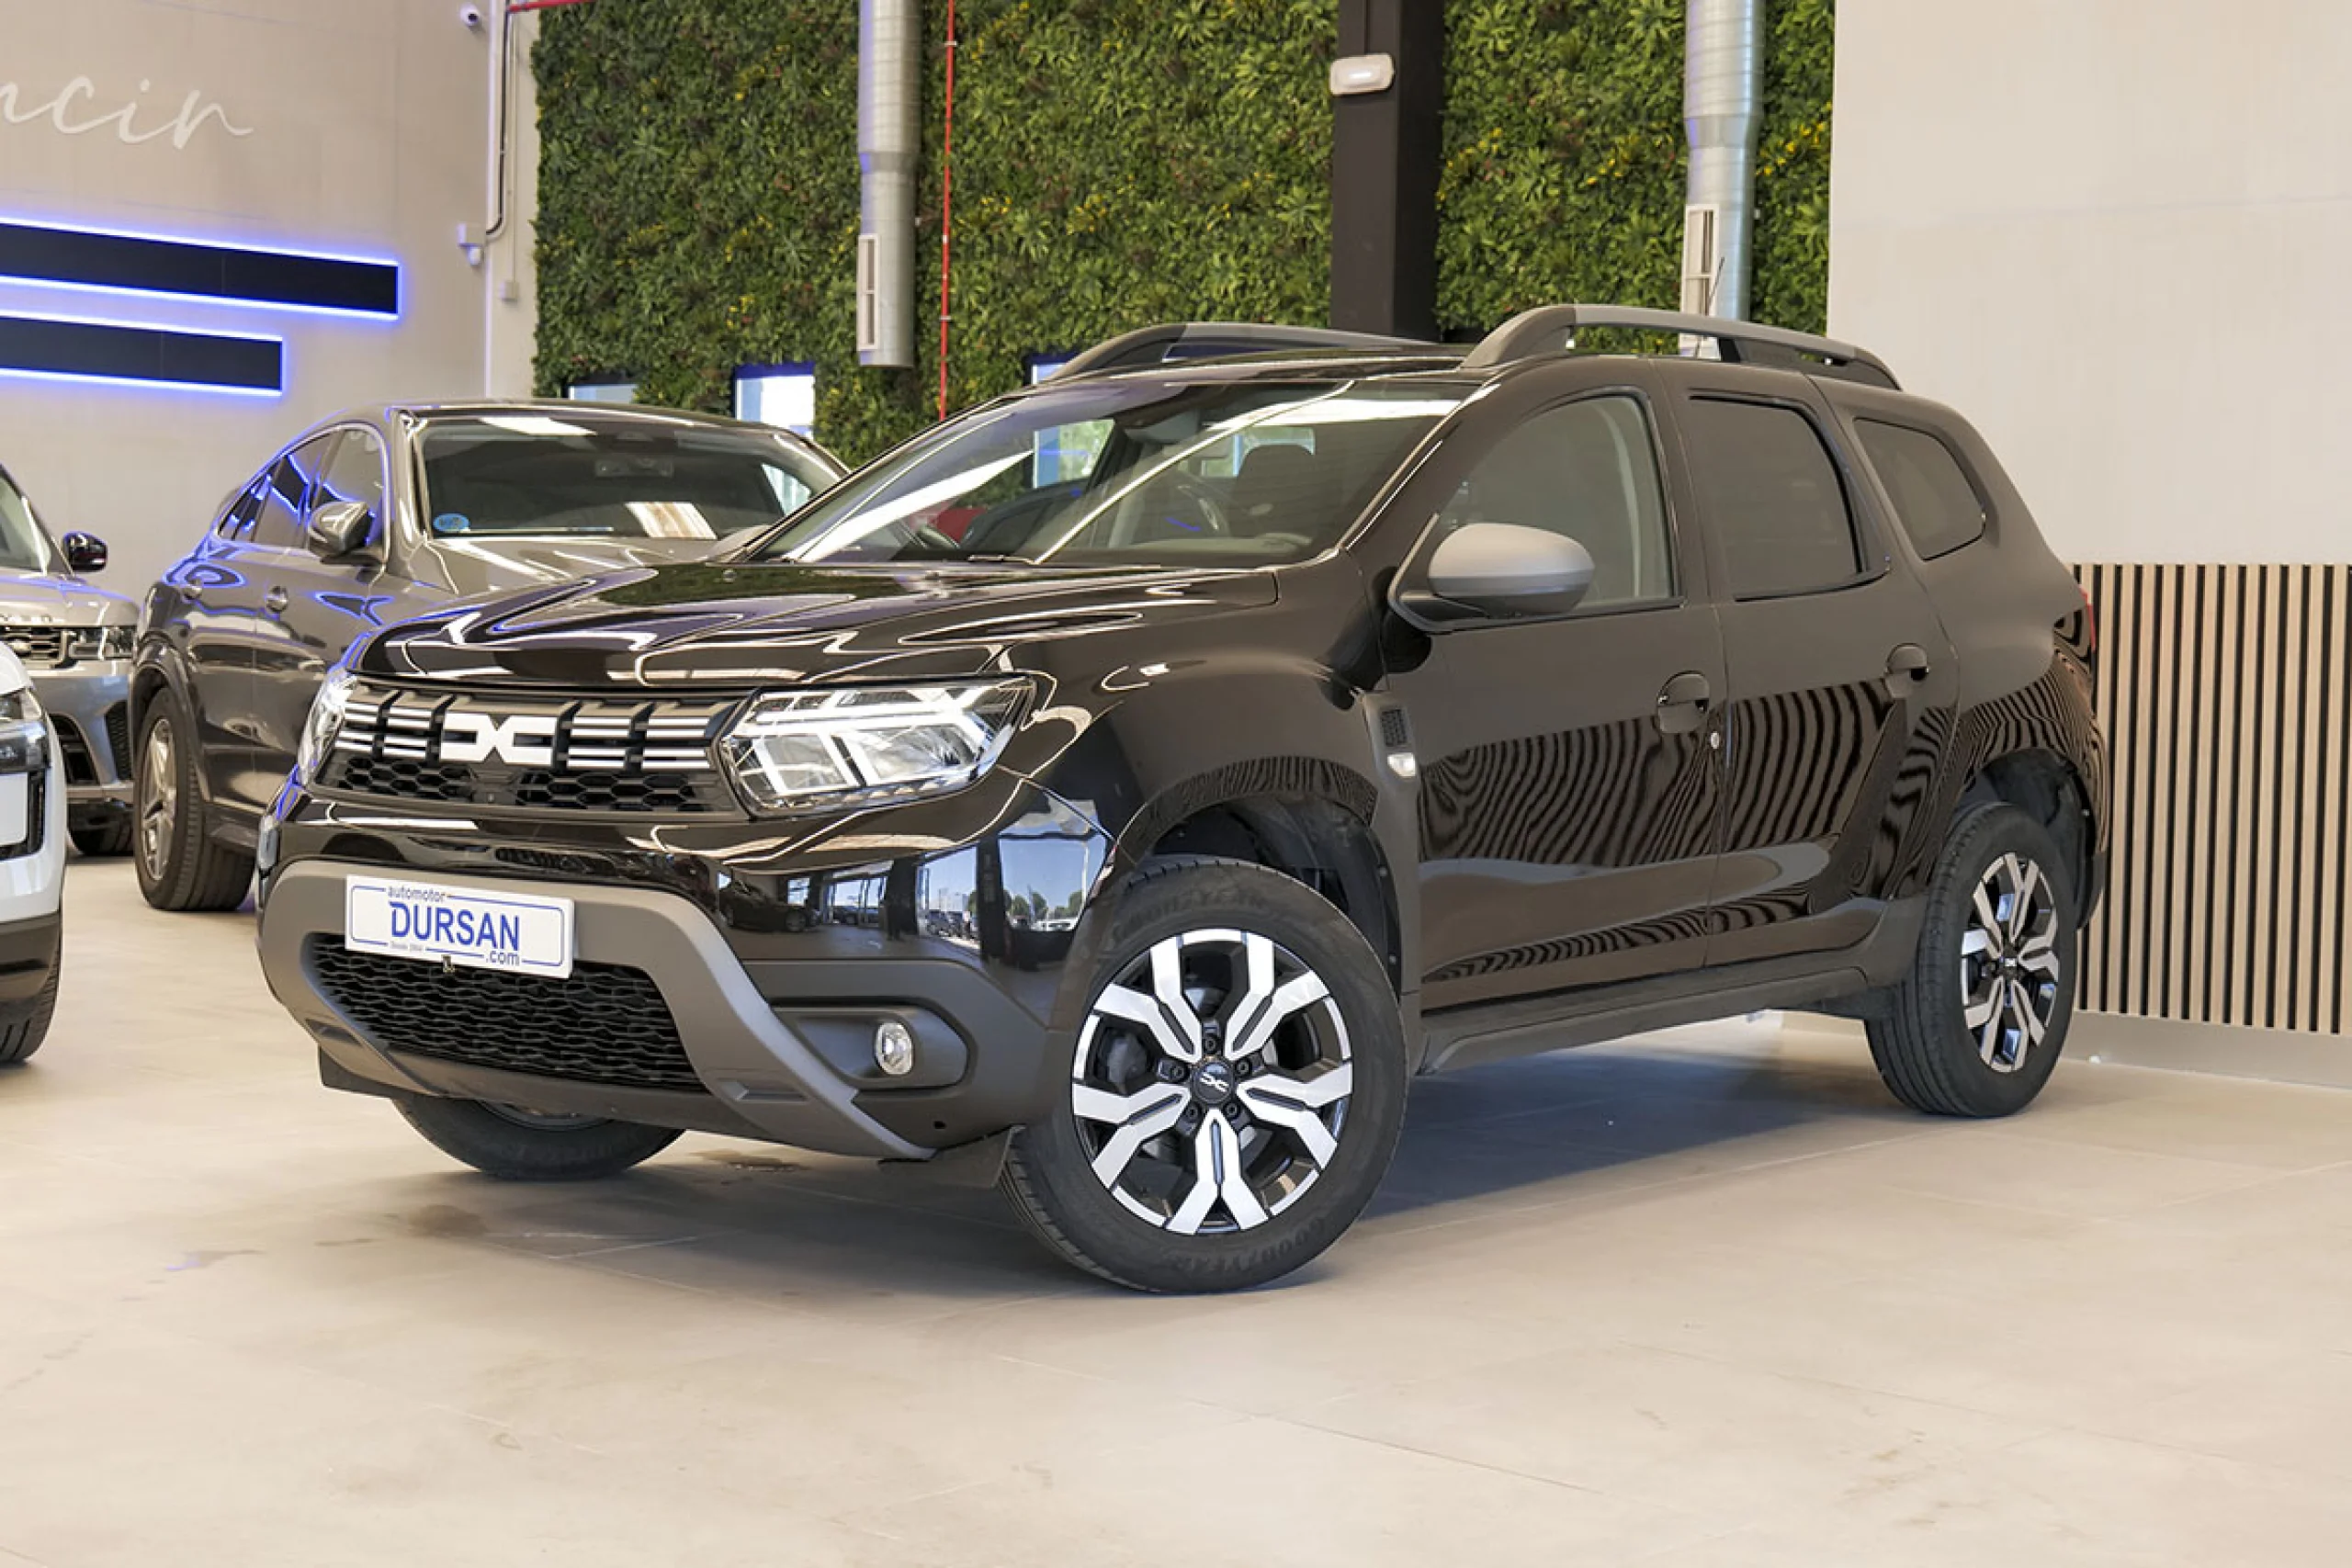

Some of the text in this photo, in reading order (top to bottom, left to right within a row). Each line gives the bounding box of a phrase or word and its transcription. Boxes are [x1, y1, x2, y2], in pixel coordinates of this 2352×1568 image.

[387, 886, 446, 902] automotor
[389, 901, 520, 951] DURSAN
[486, 950, 520, 965] .com
